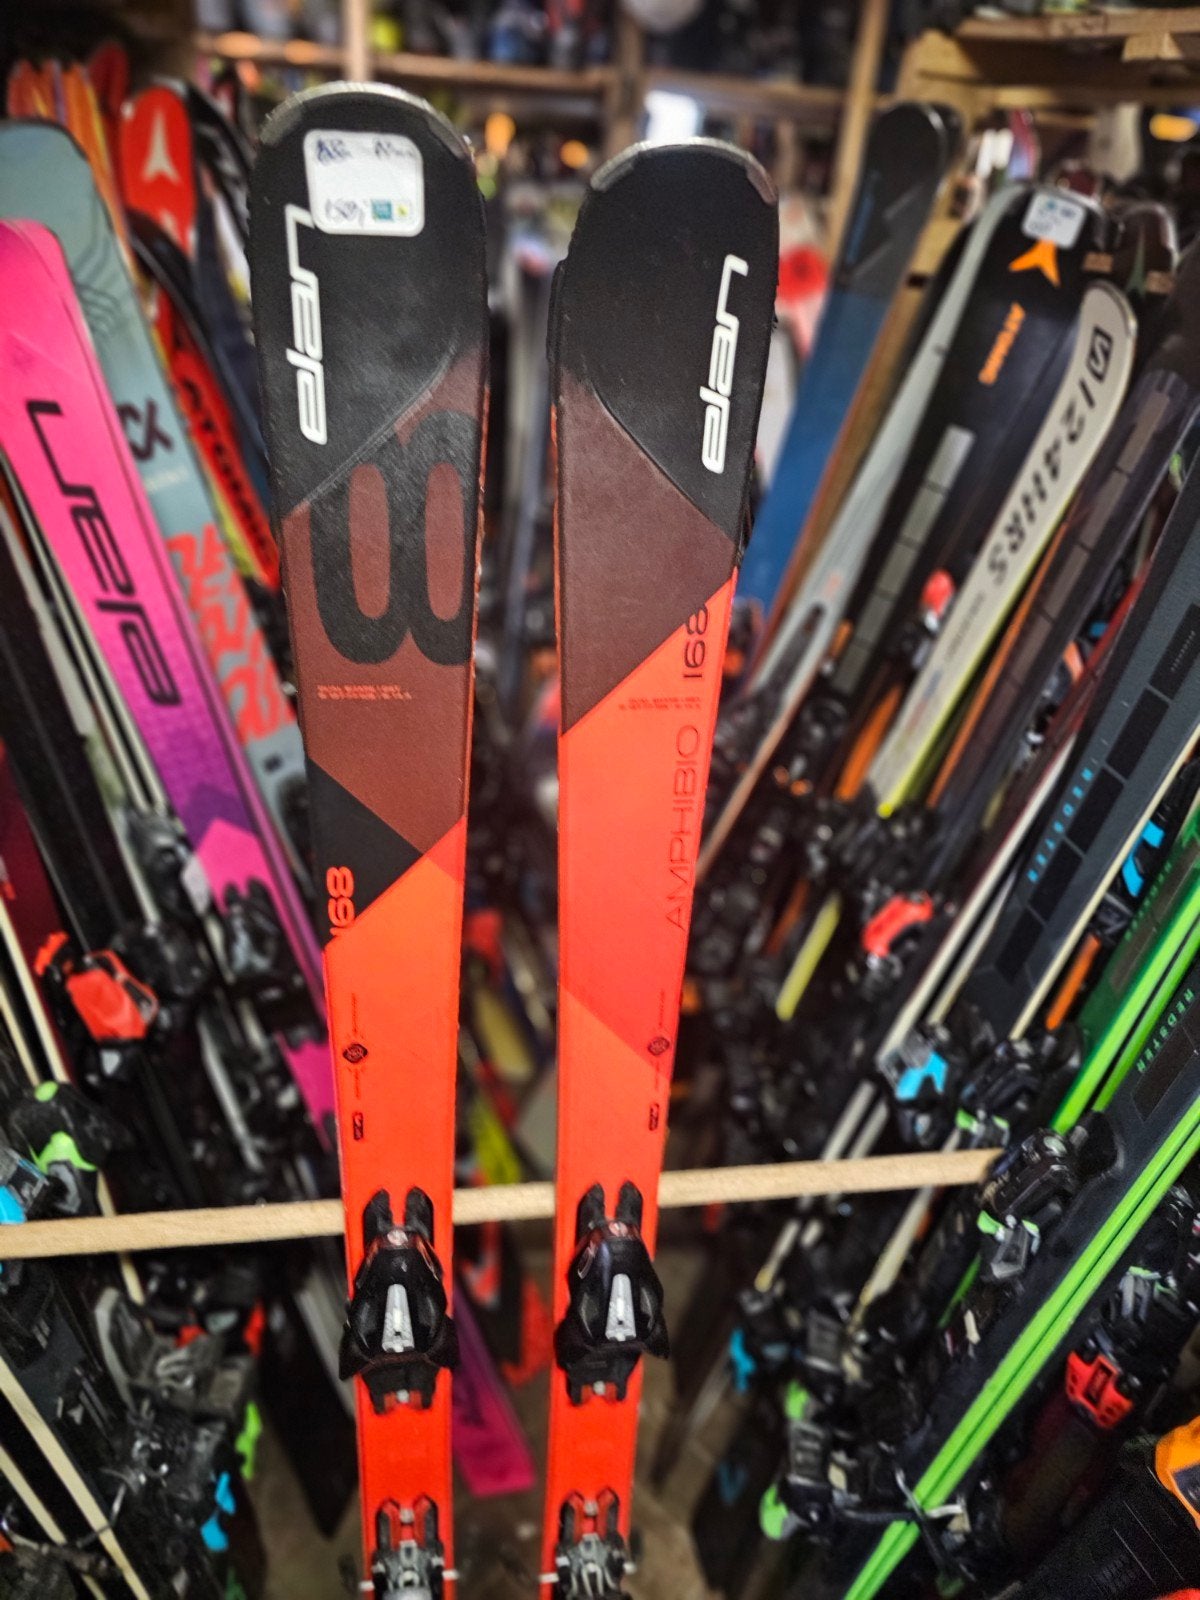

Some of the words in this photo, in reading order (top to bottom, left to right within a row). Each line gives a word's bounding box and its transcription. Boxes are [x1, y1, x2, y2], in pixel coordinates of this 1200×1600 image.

[700, 254, 749, 474] elan
[26, 399, 182, 706] elan
[665, 724, 699, 932] AMPHIBIO
[683, 604, 708, 678] 168
[1136, 988, 1194, 1075] REDSTER
